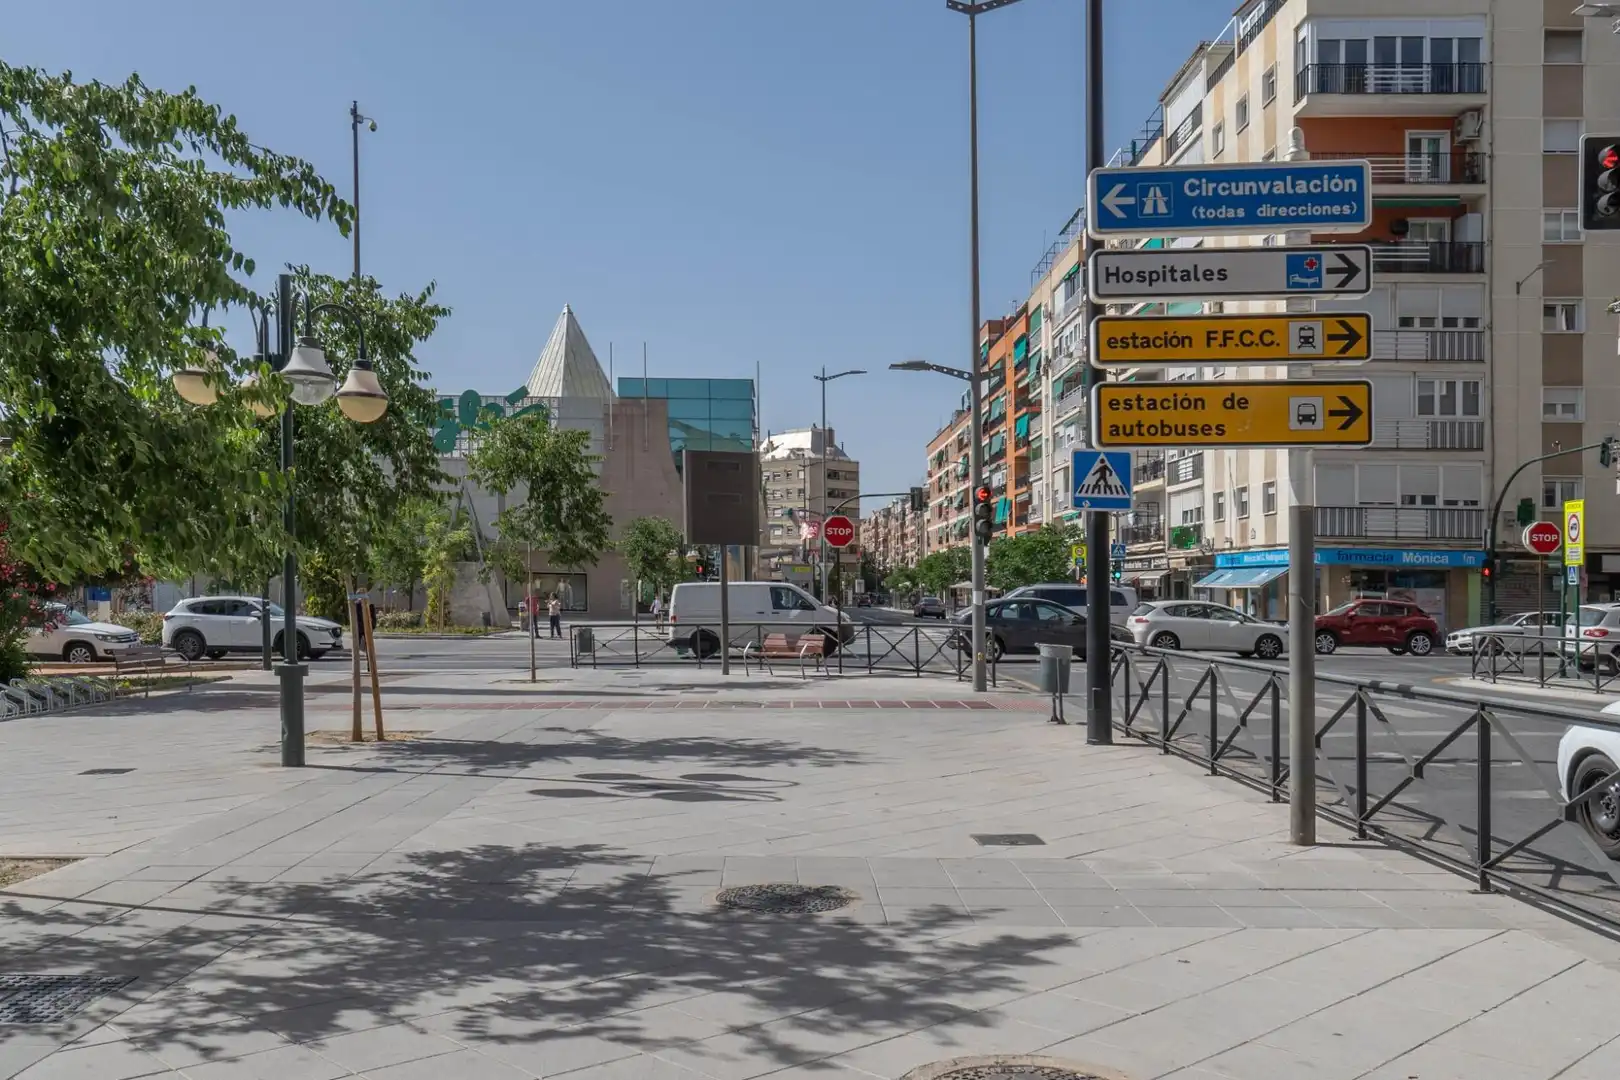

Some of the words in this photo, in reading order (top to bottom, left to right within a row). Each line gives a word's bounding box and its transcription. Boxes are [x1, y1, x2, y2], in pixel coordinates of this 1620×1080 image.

[1183, 174, 1357, 197] Circunvalación
[1191, 205, 1245, 219] (todas
[1257, 201, 1357, 218] direcciones)
[1105, 264, 1228, 287] Hospitales
[1106, 331, 1193, 349] estación
[1206, 329, 1281, 349] F.F.C.C.
[1108, 393, 1205, 411] estación
[1222, 392, 1249, 410] de
[1108, 419, 1226, 437] autobuses
[826, 527, 852, 536] STOP
[1531, 533, 1558, 542] STOP
[1337, 550, 1394, 562] farmacia
[1402, 551, 1449, 564] Mónica
